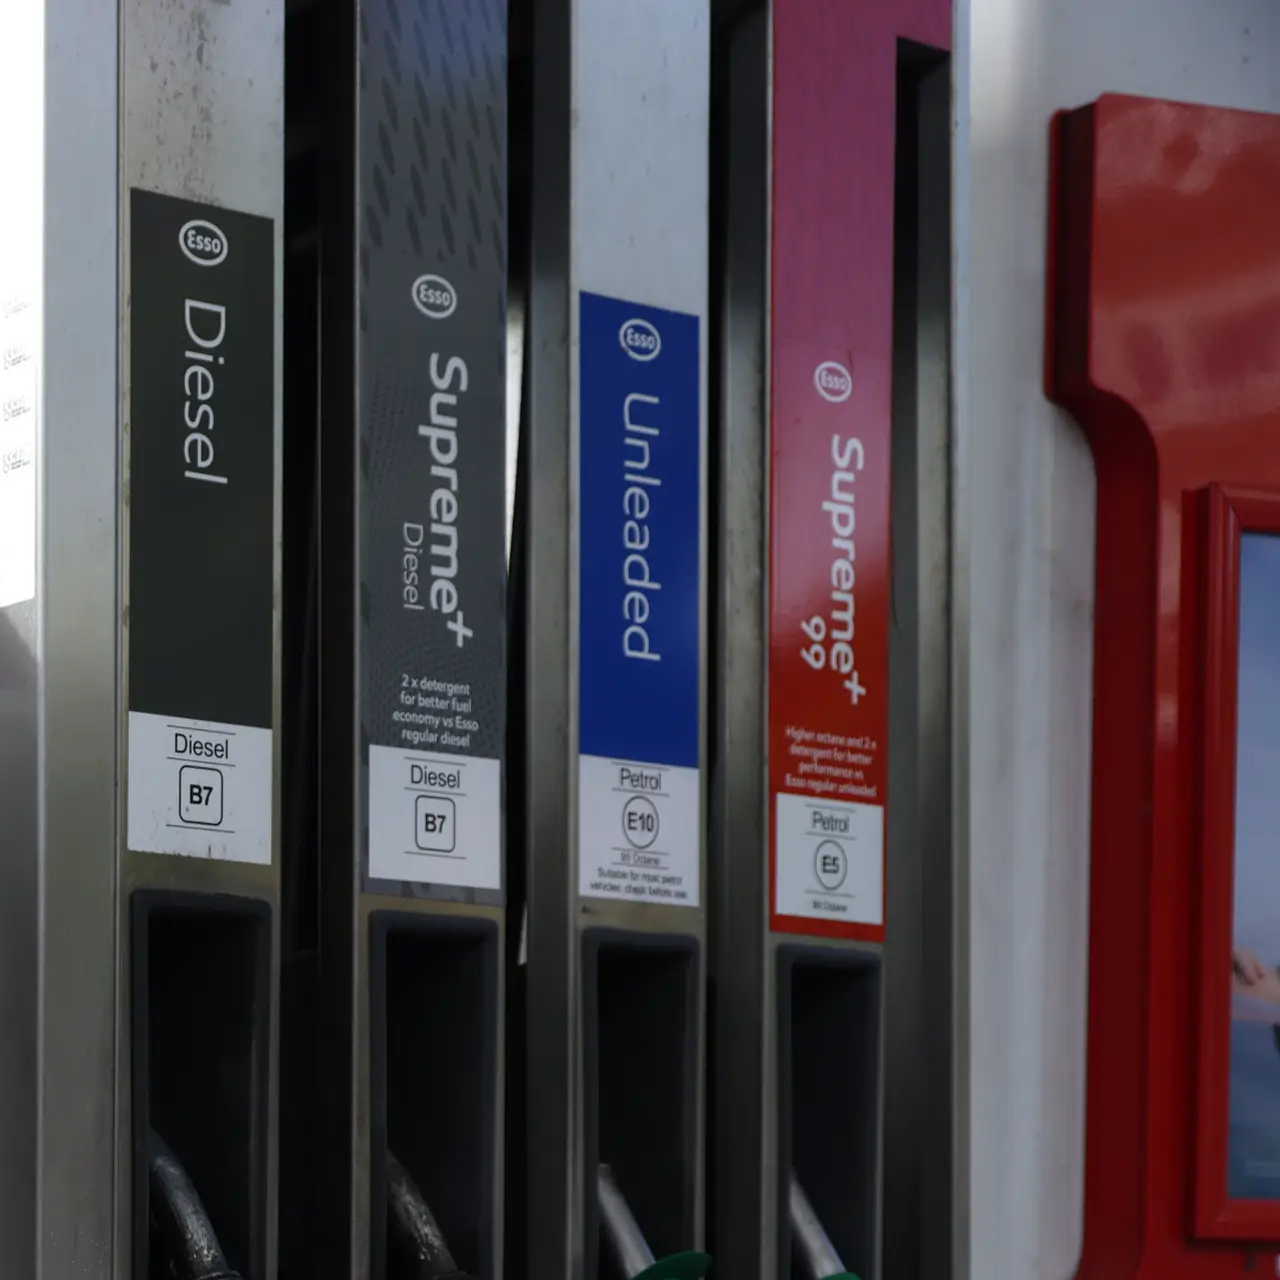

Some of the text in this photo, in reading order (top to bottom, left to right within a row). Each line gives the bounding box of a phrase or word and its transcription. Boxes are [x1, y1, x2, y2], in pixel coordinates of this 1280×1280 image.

[186, 230, 221, 254] Esso
[419, 283, 451, 306] Esso
[627, 327, 656, 350] Esso
[184, 298, 228, 484] Diesel
[821, 370, 847, 392] Esso
[623, 393, 662, 662] Unleaded
[403, 522, 425, 610] Diesel
[800, 615, 826, 670] 99
[402, 674, 471, 697] 2 x detergent
[400, 691, 472, 713] for better fuel
[393, 711, 479, 732] economy vs Esso
[174, 733, 229, 759] Diesel
[401, 728, 471, 747] regular diesel
[785, 725, 815, 744] Higher
[816, 731, 845, 745] octane
[789, 742, 873, 765] detergent better
[410, 764, 461, 789] Diesel
[620, 767, 662, 790] Petrol
[798, 761, 853, 777] performance
[190, 784, 213, 806] B7
[785, 773, 877, 797] Esso regular unleaded
[424, 812, 446, 834] B7
[627, 811, 654, 832] E10
[812, 811, 850, 833] Petrol
[821, 855, 840, 874] E5
